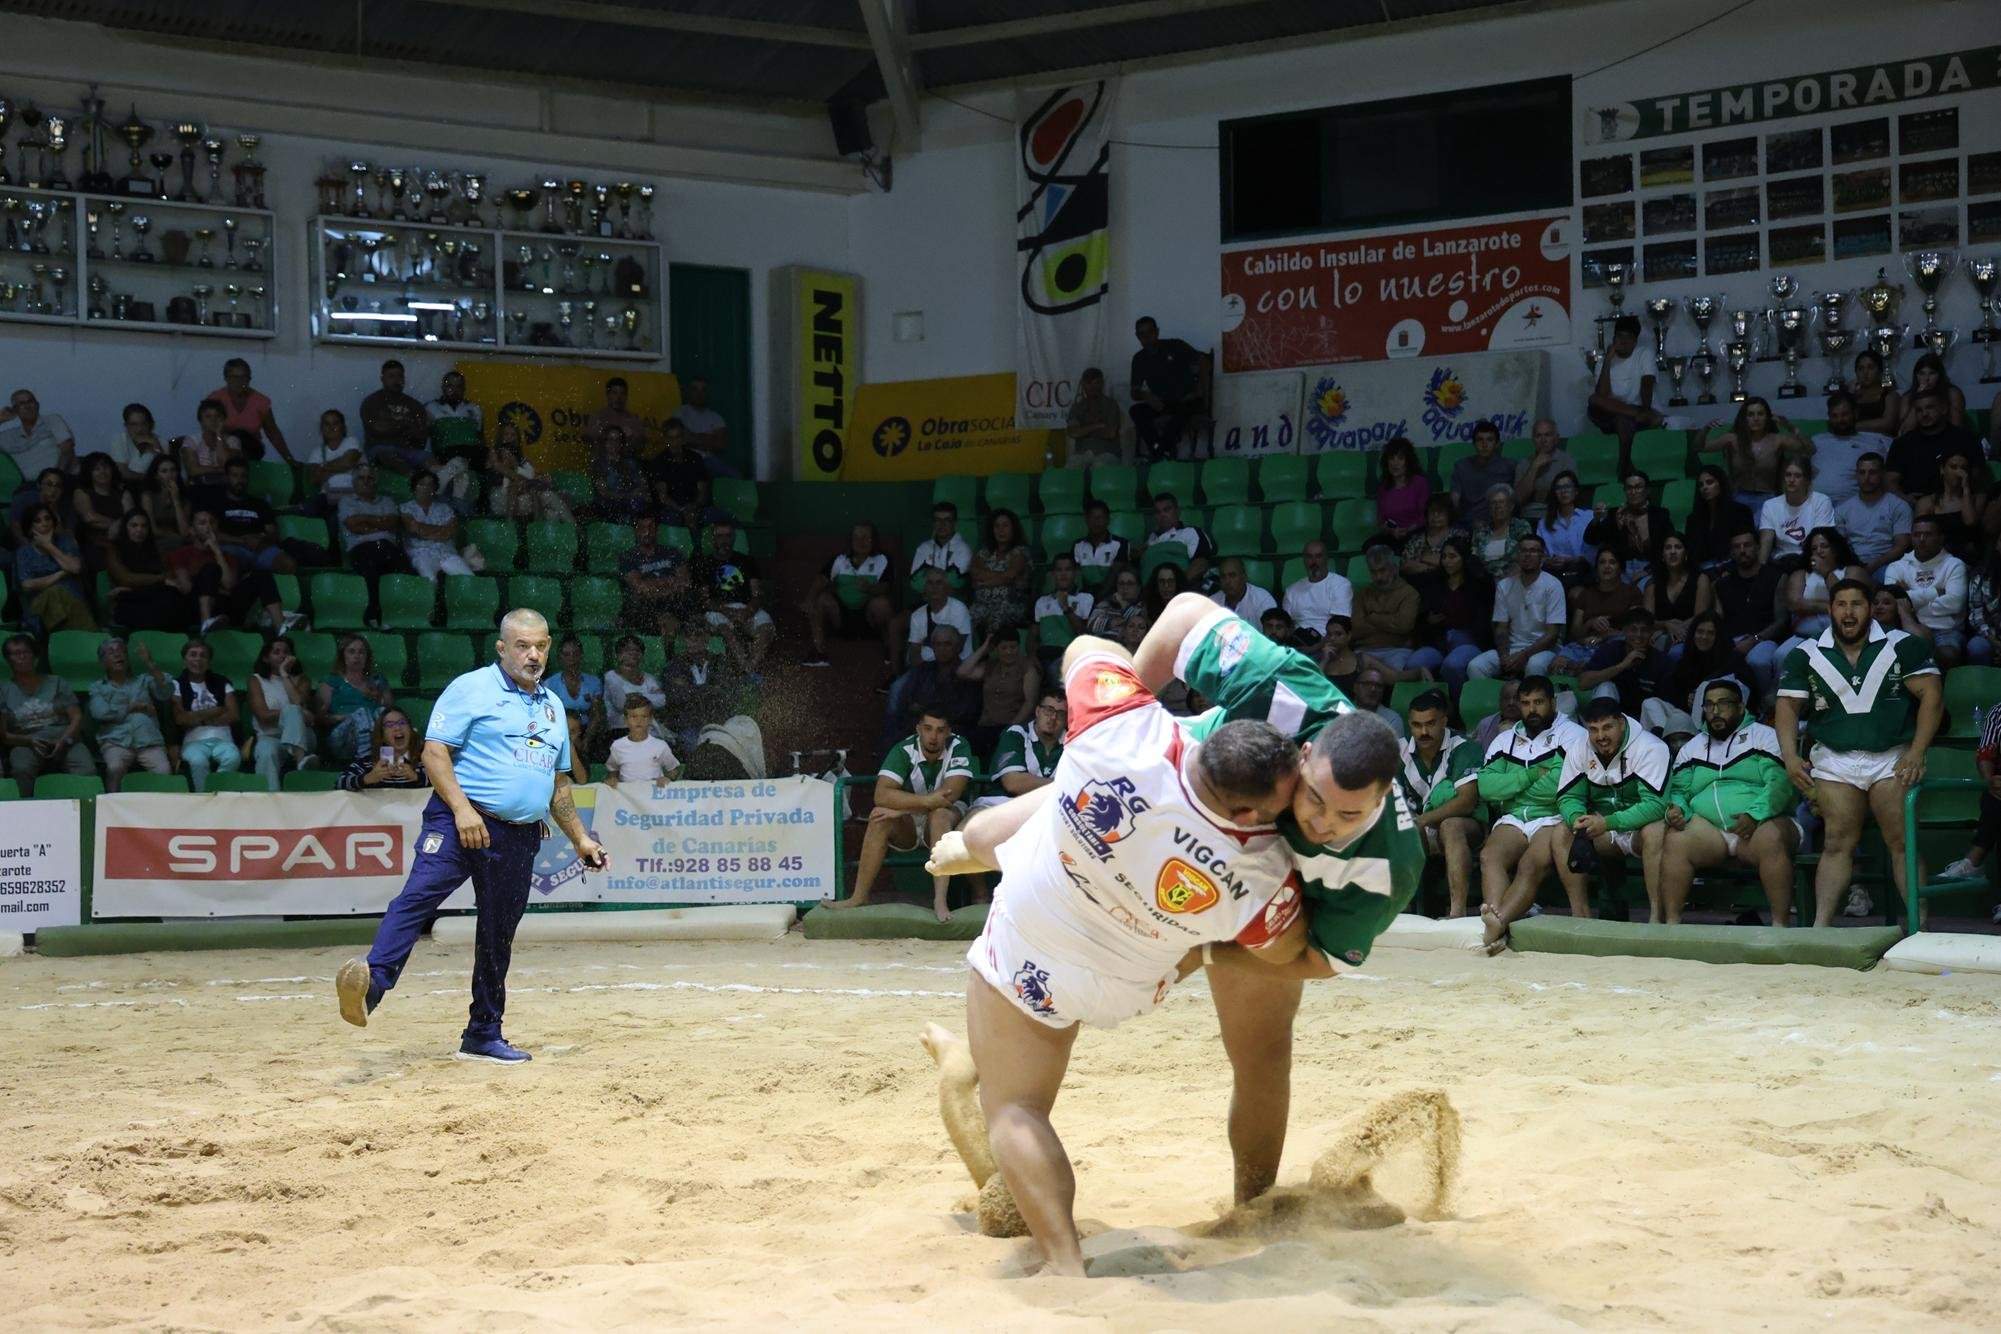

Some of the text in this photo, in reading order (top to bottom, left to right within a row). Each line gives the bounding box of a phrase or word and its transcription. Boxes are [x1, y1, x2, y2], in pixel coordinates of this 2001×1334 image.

[1655, 56, 1973, 132] TEMPORADA
[1243, 230, 1521, 276] Cabildo Insular de Lanzarote
[1257, 252, 1520, 313] con lo nuestro
[813, 289, 843, 473] NETTO
[1026, 381, 1073, 408] CIC
[1422, 408, 1528, 441] aquaark
[651, 783, 777, 801] Empresa de
[1110, 776, 1152, 813] RG
[614, 808, 815, 830] Seguridad Privada
[33, 844, 52, 857] "A"
[168, 832, 394, 874] SPAR
[652, 837, 777, 854] de Canarias
[0, 865, 32, 876] arote
[550, 857, 587, 887] SEGU
[636, 856, 803, 873] Tlf.:928 85 88 45
[1173, 826, 1250, 901] VIGCAN
[0, 880, 66, 895] 659628352
[607, 874, 821, 892] info@atlantisegur.com
